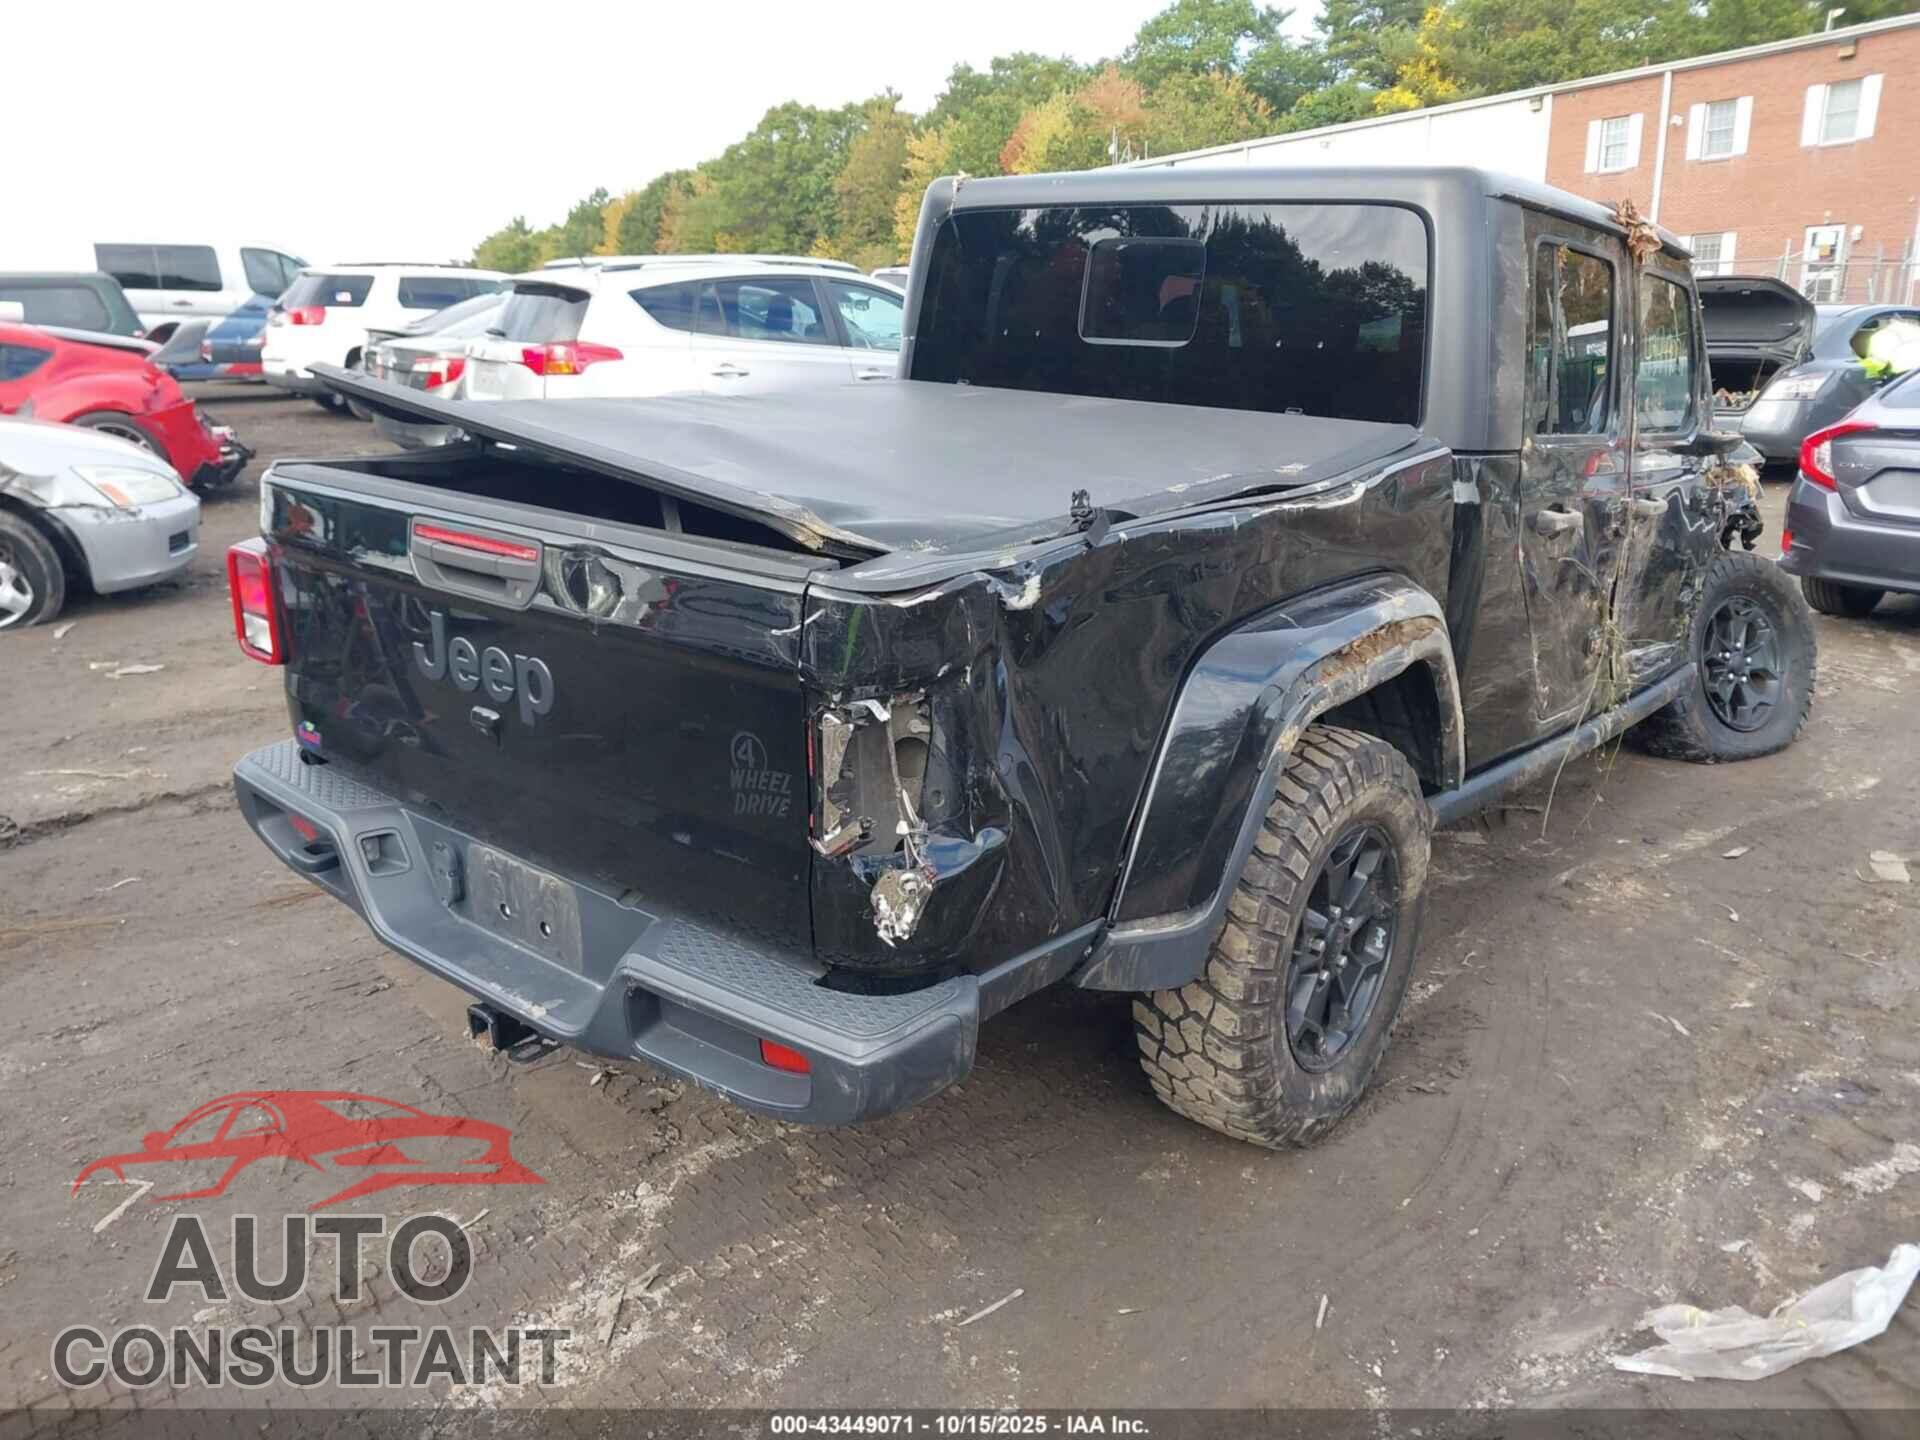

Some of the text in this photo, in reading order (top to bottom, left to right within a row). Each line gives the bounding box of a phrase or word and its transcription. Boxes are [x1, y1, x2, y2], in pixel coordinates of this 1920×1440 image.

[412, 611, 555, 728] Jeep
[735, 738, 755, 768] 4
[730, 768, 792, 794] WHEEL
[735, 792, 791, 817] DRIVE
